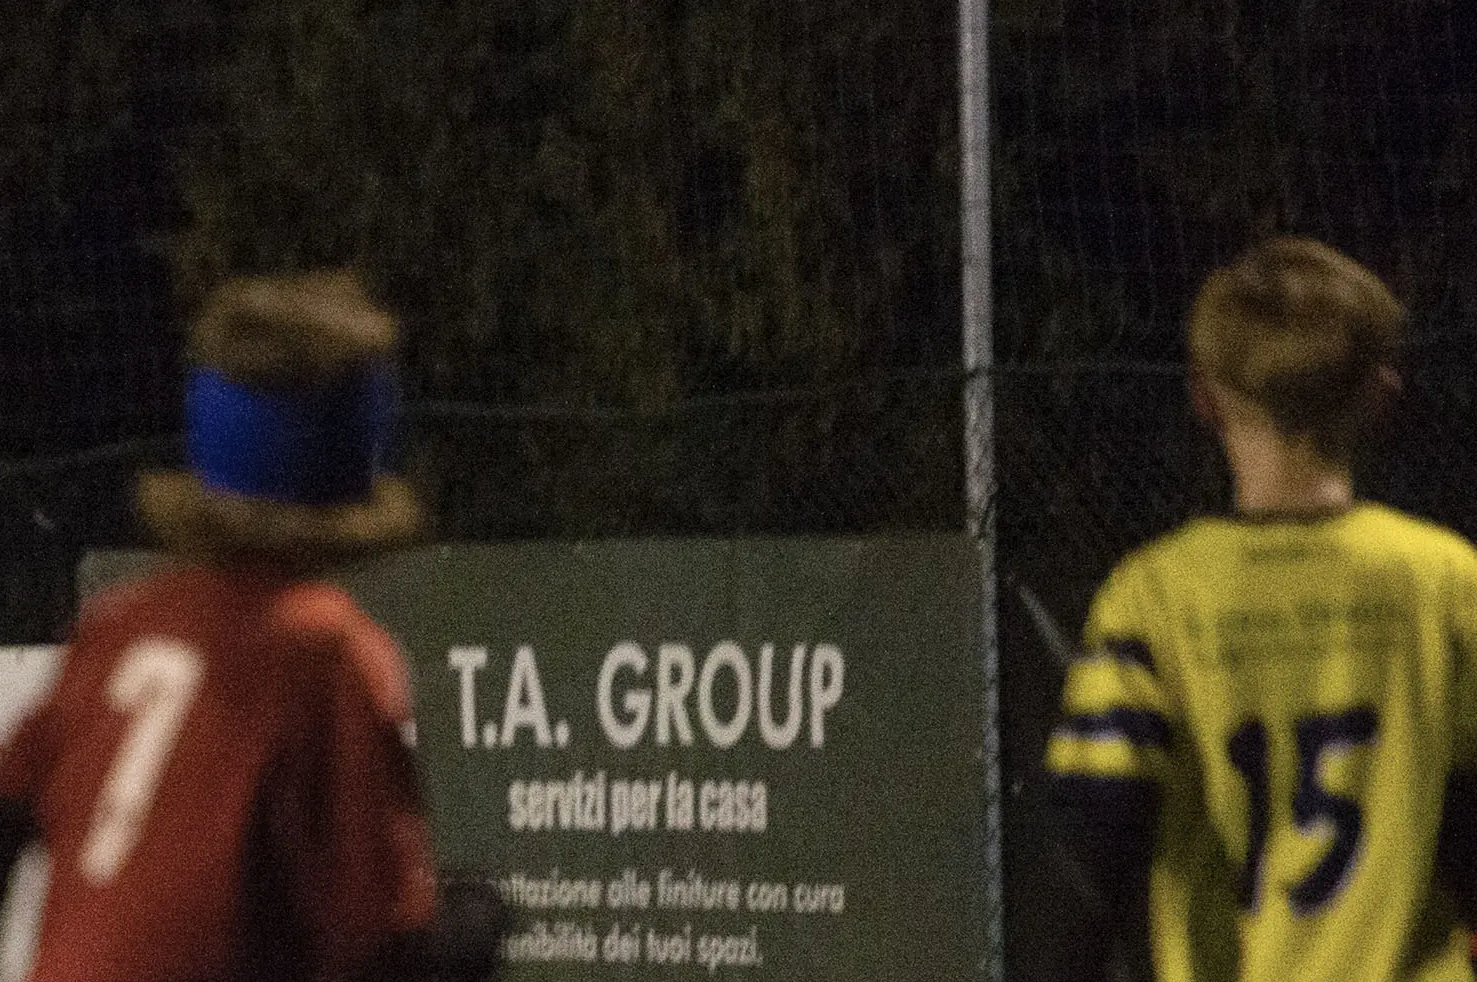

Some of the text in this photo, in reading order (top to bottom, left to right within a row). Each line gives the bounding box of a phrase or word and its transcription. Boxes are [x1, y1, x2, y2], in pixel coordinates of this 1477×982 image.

[447, 640, 845, 750] T.A. GROUP
[509, 771, 768, 837] servizi per la casa
[1228, 706, 1384, 920] 15
[608, 868, 650, 909] alle
[658, 868, 740, 911] finiture
[747, 882, 787, 912] con
[794, 882, 845, 914] cura
[603, 922, 640, 964] dei
[648, 924, 692, 965] tuoi
